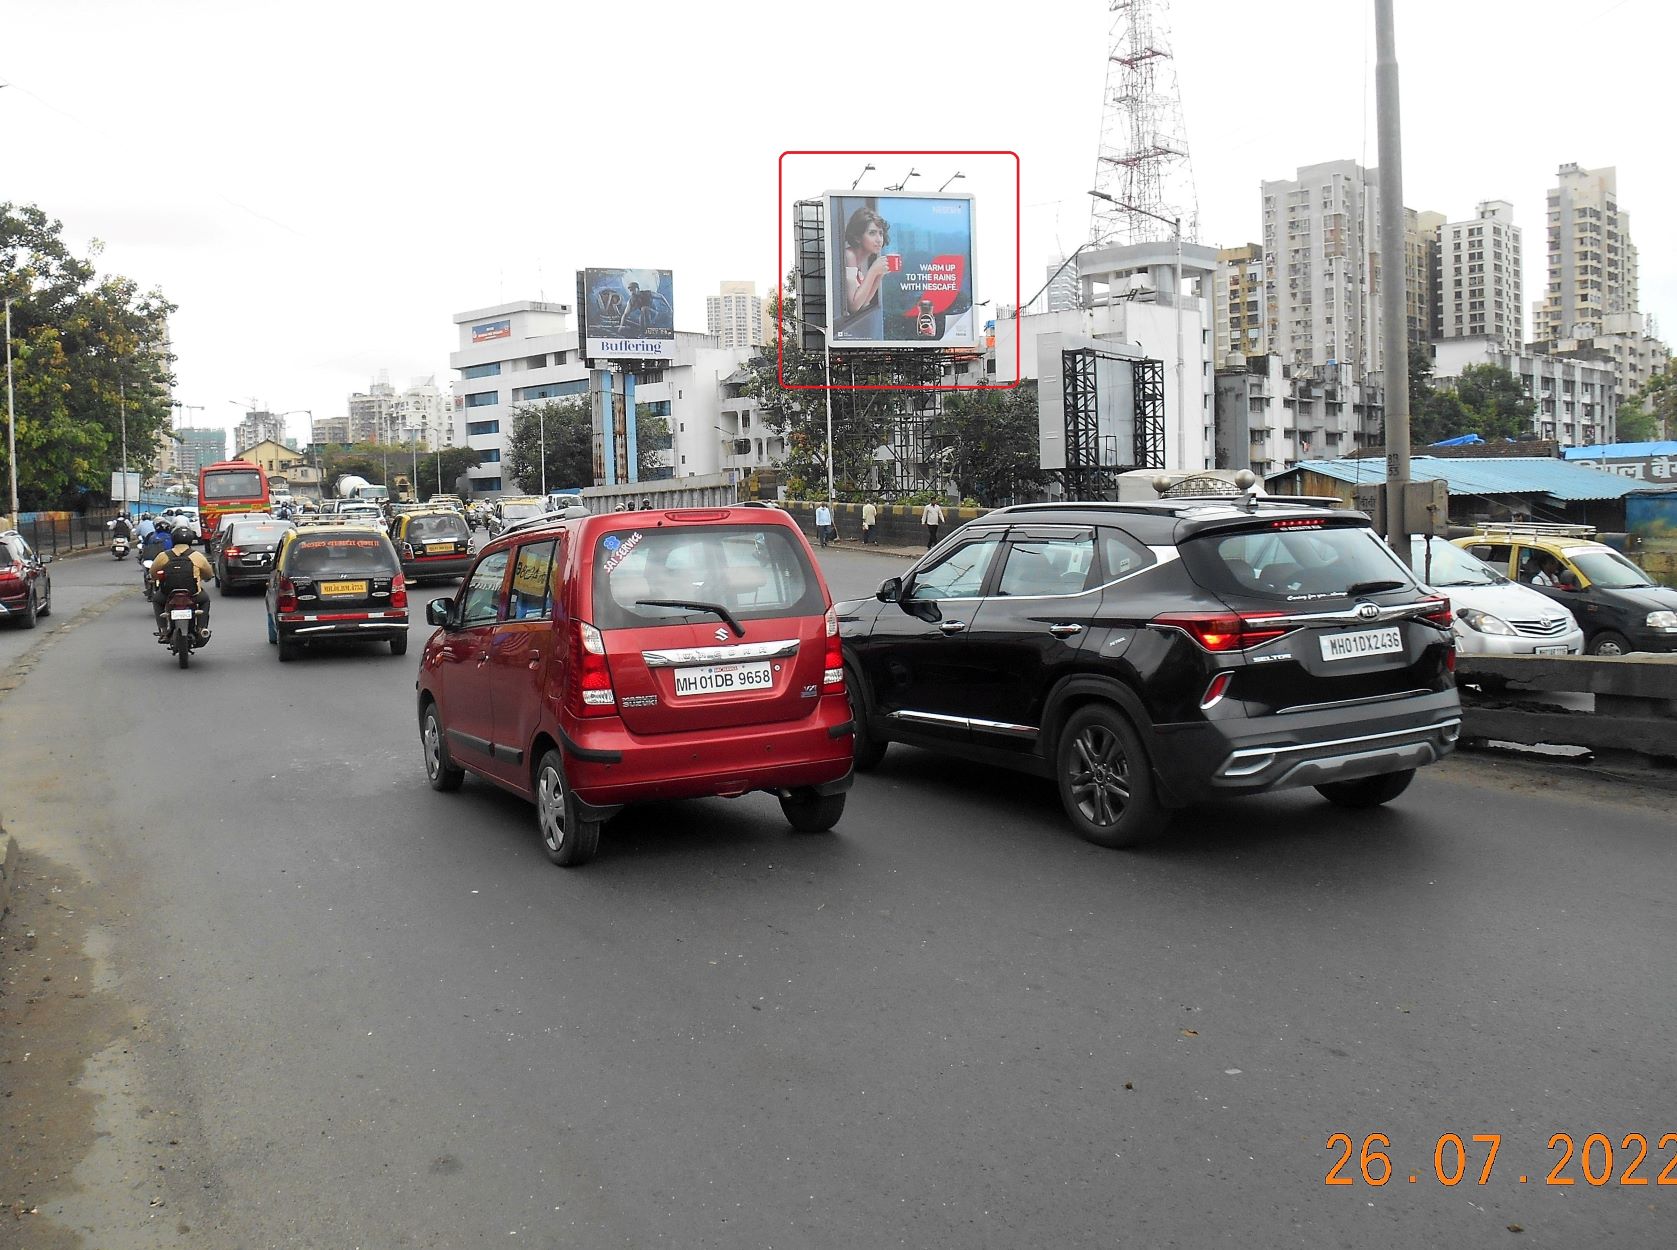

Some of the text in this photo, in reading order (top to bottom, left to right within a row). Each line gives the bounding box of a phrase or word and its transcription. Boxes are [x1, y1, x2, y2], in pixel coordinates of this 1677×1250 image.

[919, 263, 956, 272] WARM UP
[906, 273, 957, 282] TO THE RAINS
[900, 282, 921, 291] WITH
[601, 340, 662, 355] Buffering
[603, 531, 643, 573] SAI SERVICE
[1360, 606, 1378, 618] KIA
[1330, 632, 1400, 655] MH01DX2436
[738, 669, 771, 685] 9658
[622, 700, 658, 708] SUZUKI
